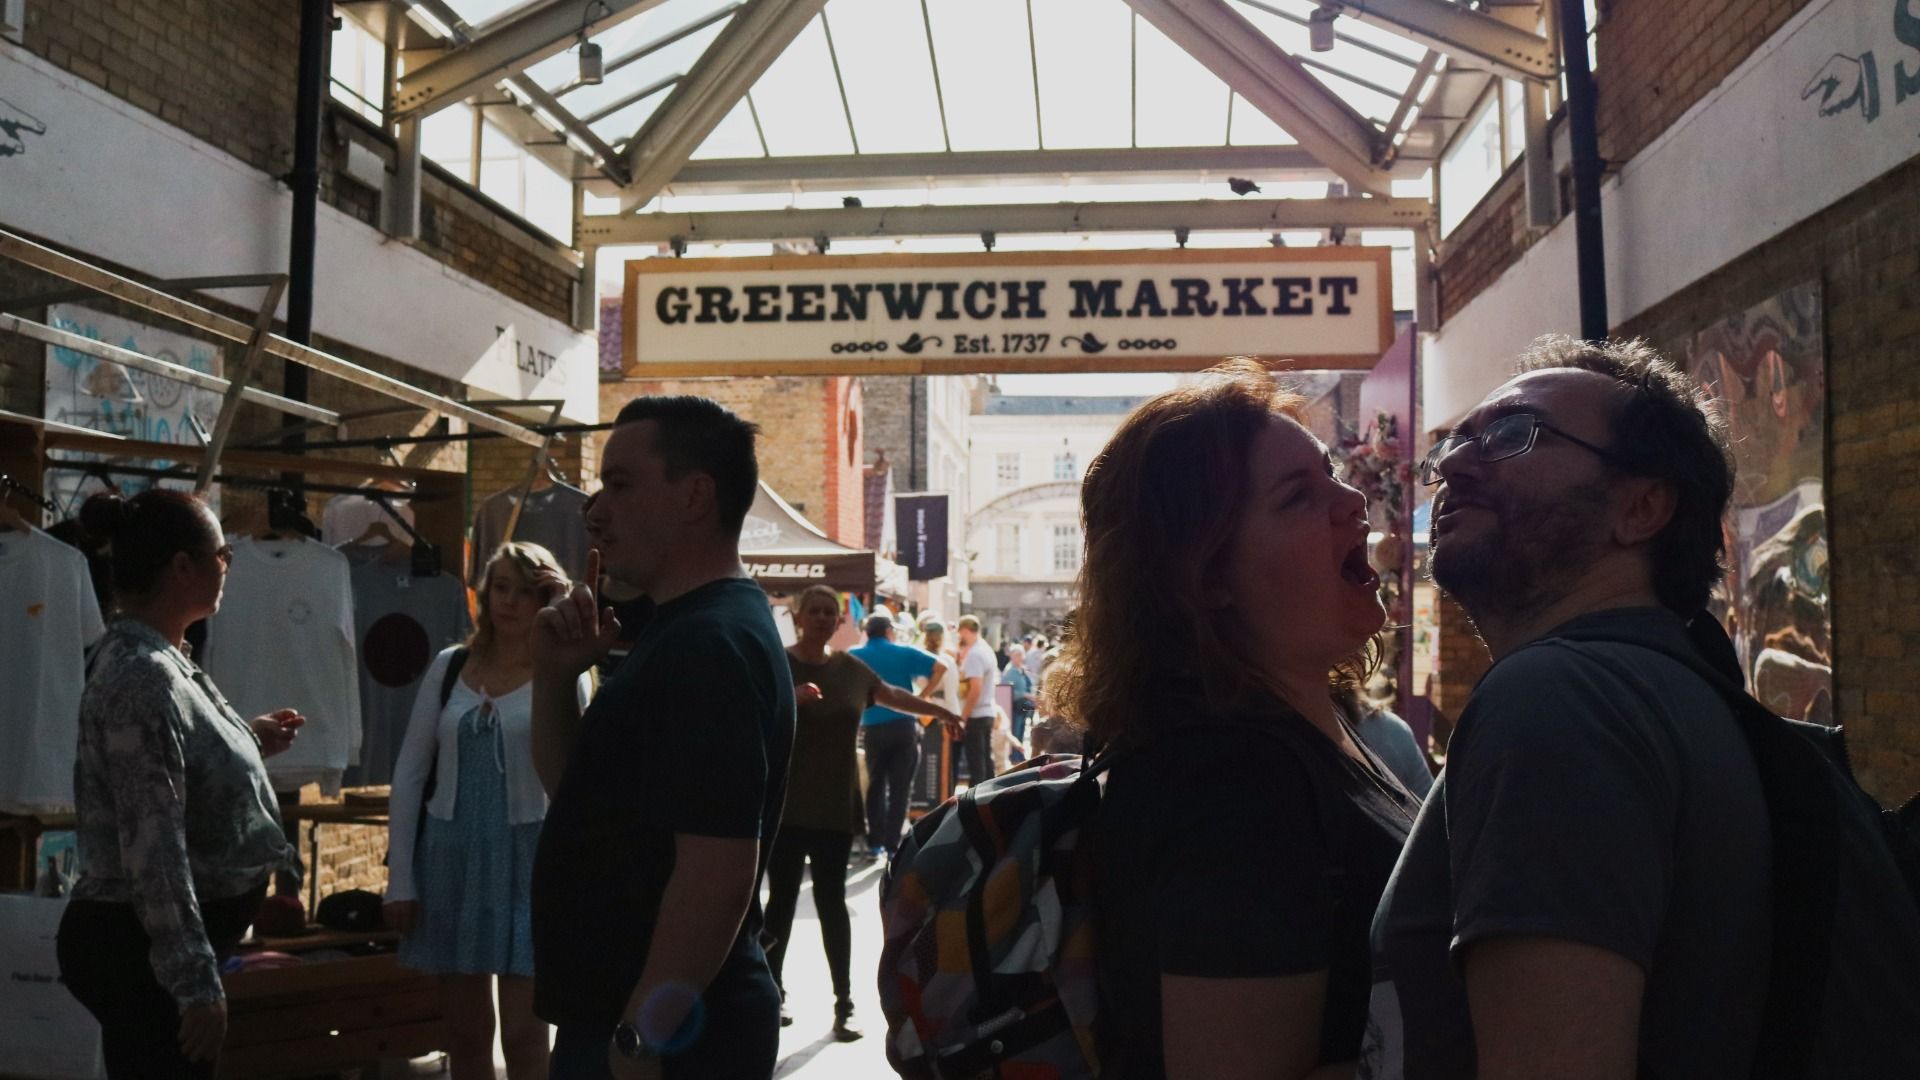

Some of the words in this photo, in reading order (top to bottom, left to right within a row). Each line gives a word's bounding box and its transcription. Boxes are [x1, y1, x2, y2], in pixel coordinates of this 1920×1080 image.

[655, 280, 1047, 325] GREENWICH
[1068, 276, 1358, 318] MARKET
[953, 333, 995, 354] Est.
[1001, 332, 1051, 353] 1737
